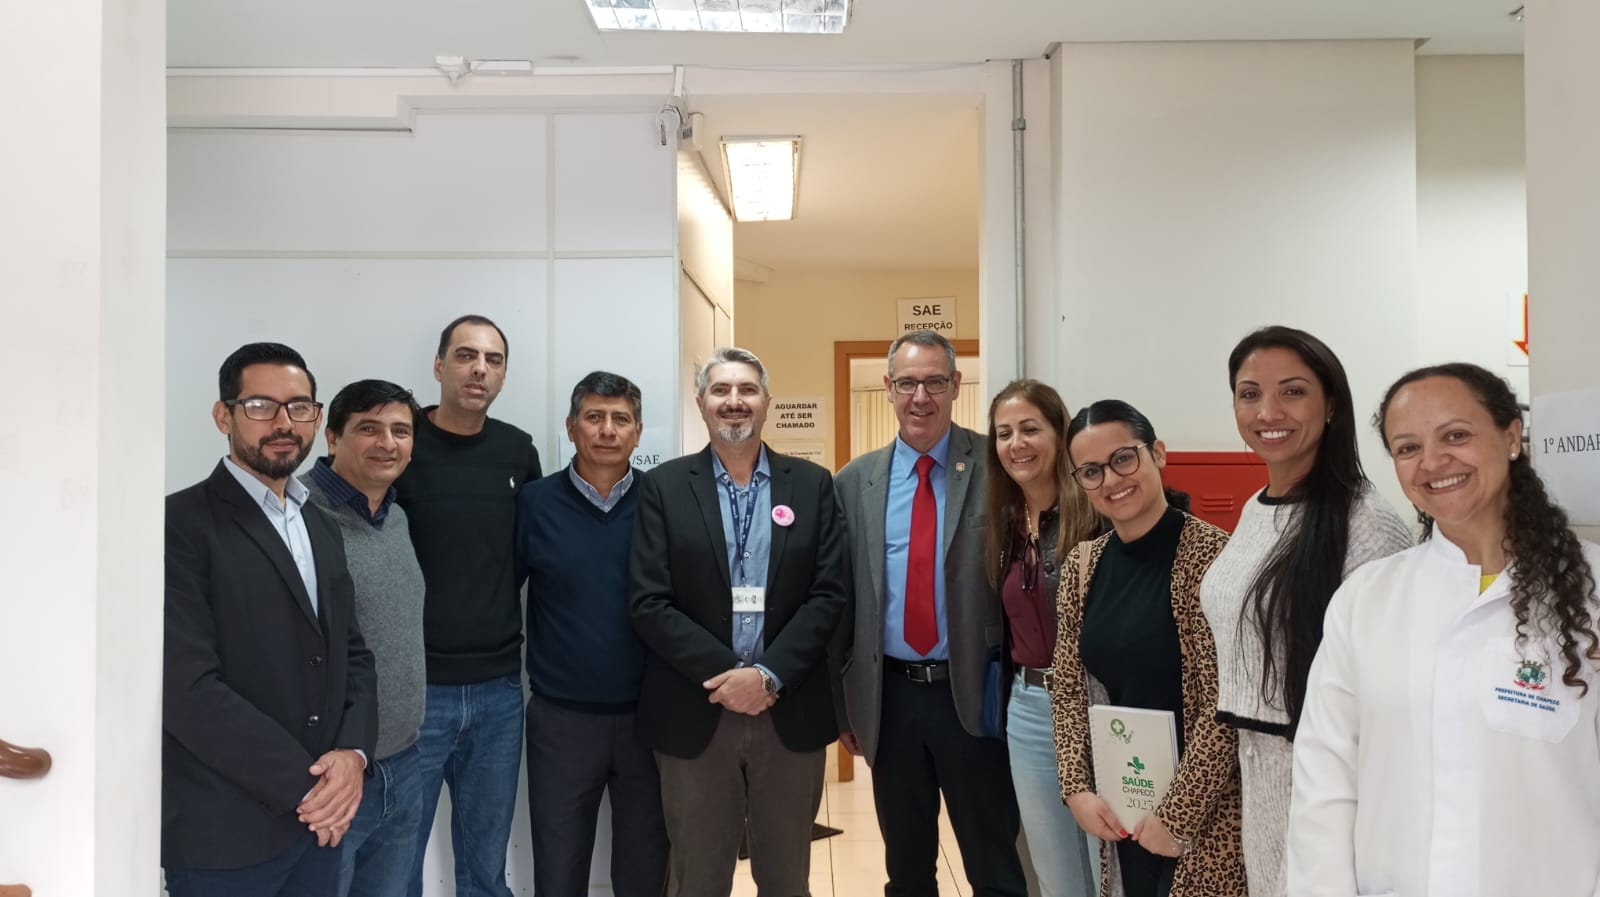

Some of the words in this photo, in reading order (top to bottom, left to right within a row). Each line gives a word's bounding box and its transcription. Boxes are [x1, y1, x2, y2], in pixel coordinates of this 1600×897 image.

[912, 304, 942, 316] SAE
[904, 320, 953, 331] RECEPÇÃO
[1121, 776, 1154, 789] SAÚDE
[1126, 797, 1154, 811] 2025
